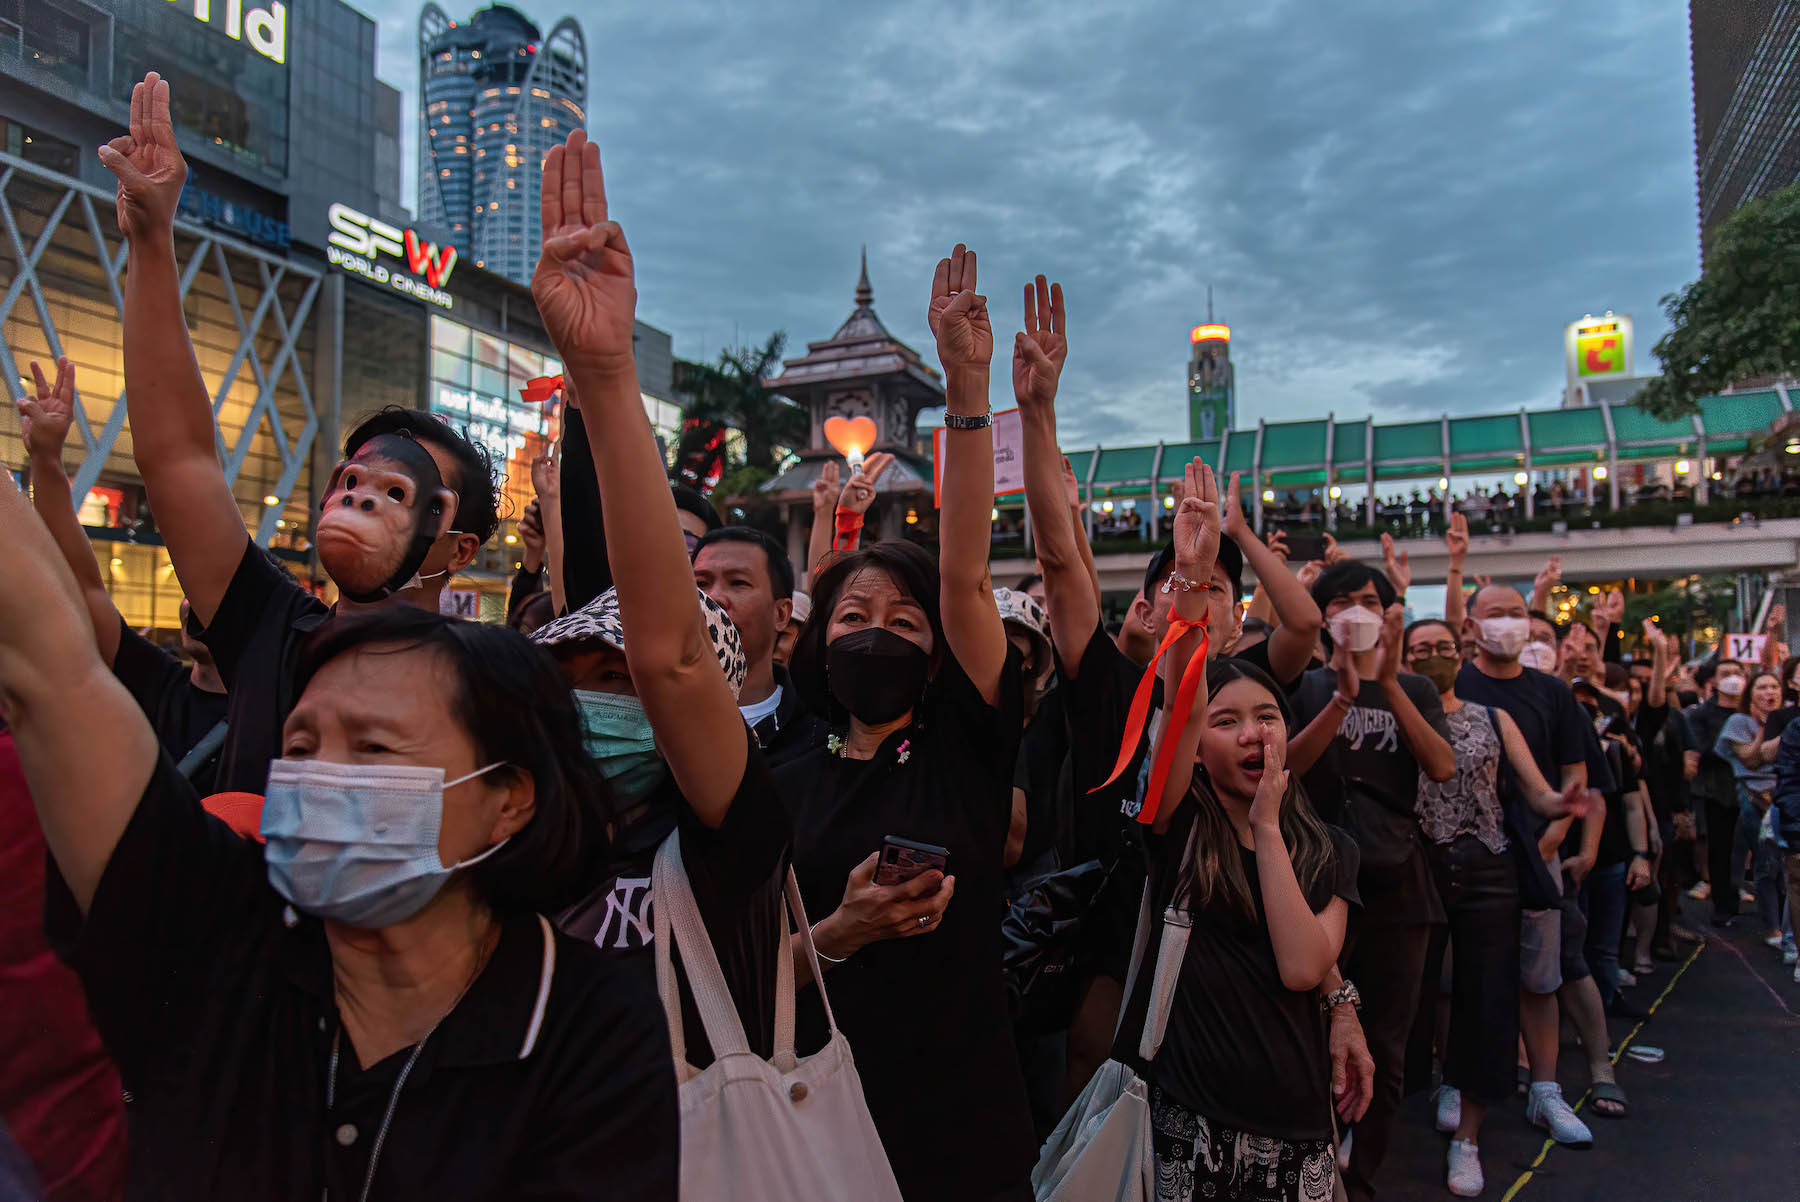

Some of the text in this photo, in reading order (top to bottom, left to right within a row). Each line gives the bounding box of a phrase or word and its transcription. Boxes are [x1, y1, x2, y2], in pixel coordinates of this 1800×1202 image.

[193, 0, 286, 64] ld
[327, 246, 453, 309] WORLD CINEMA
